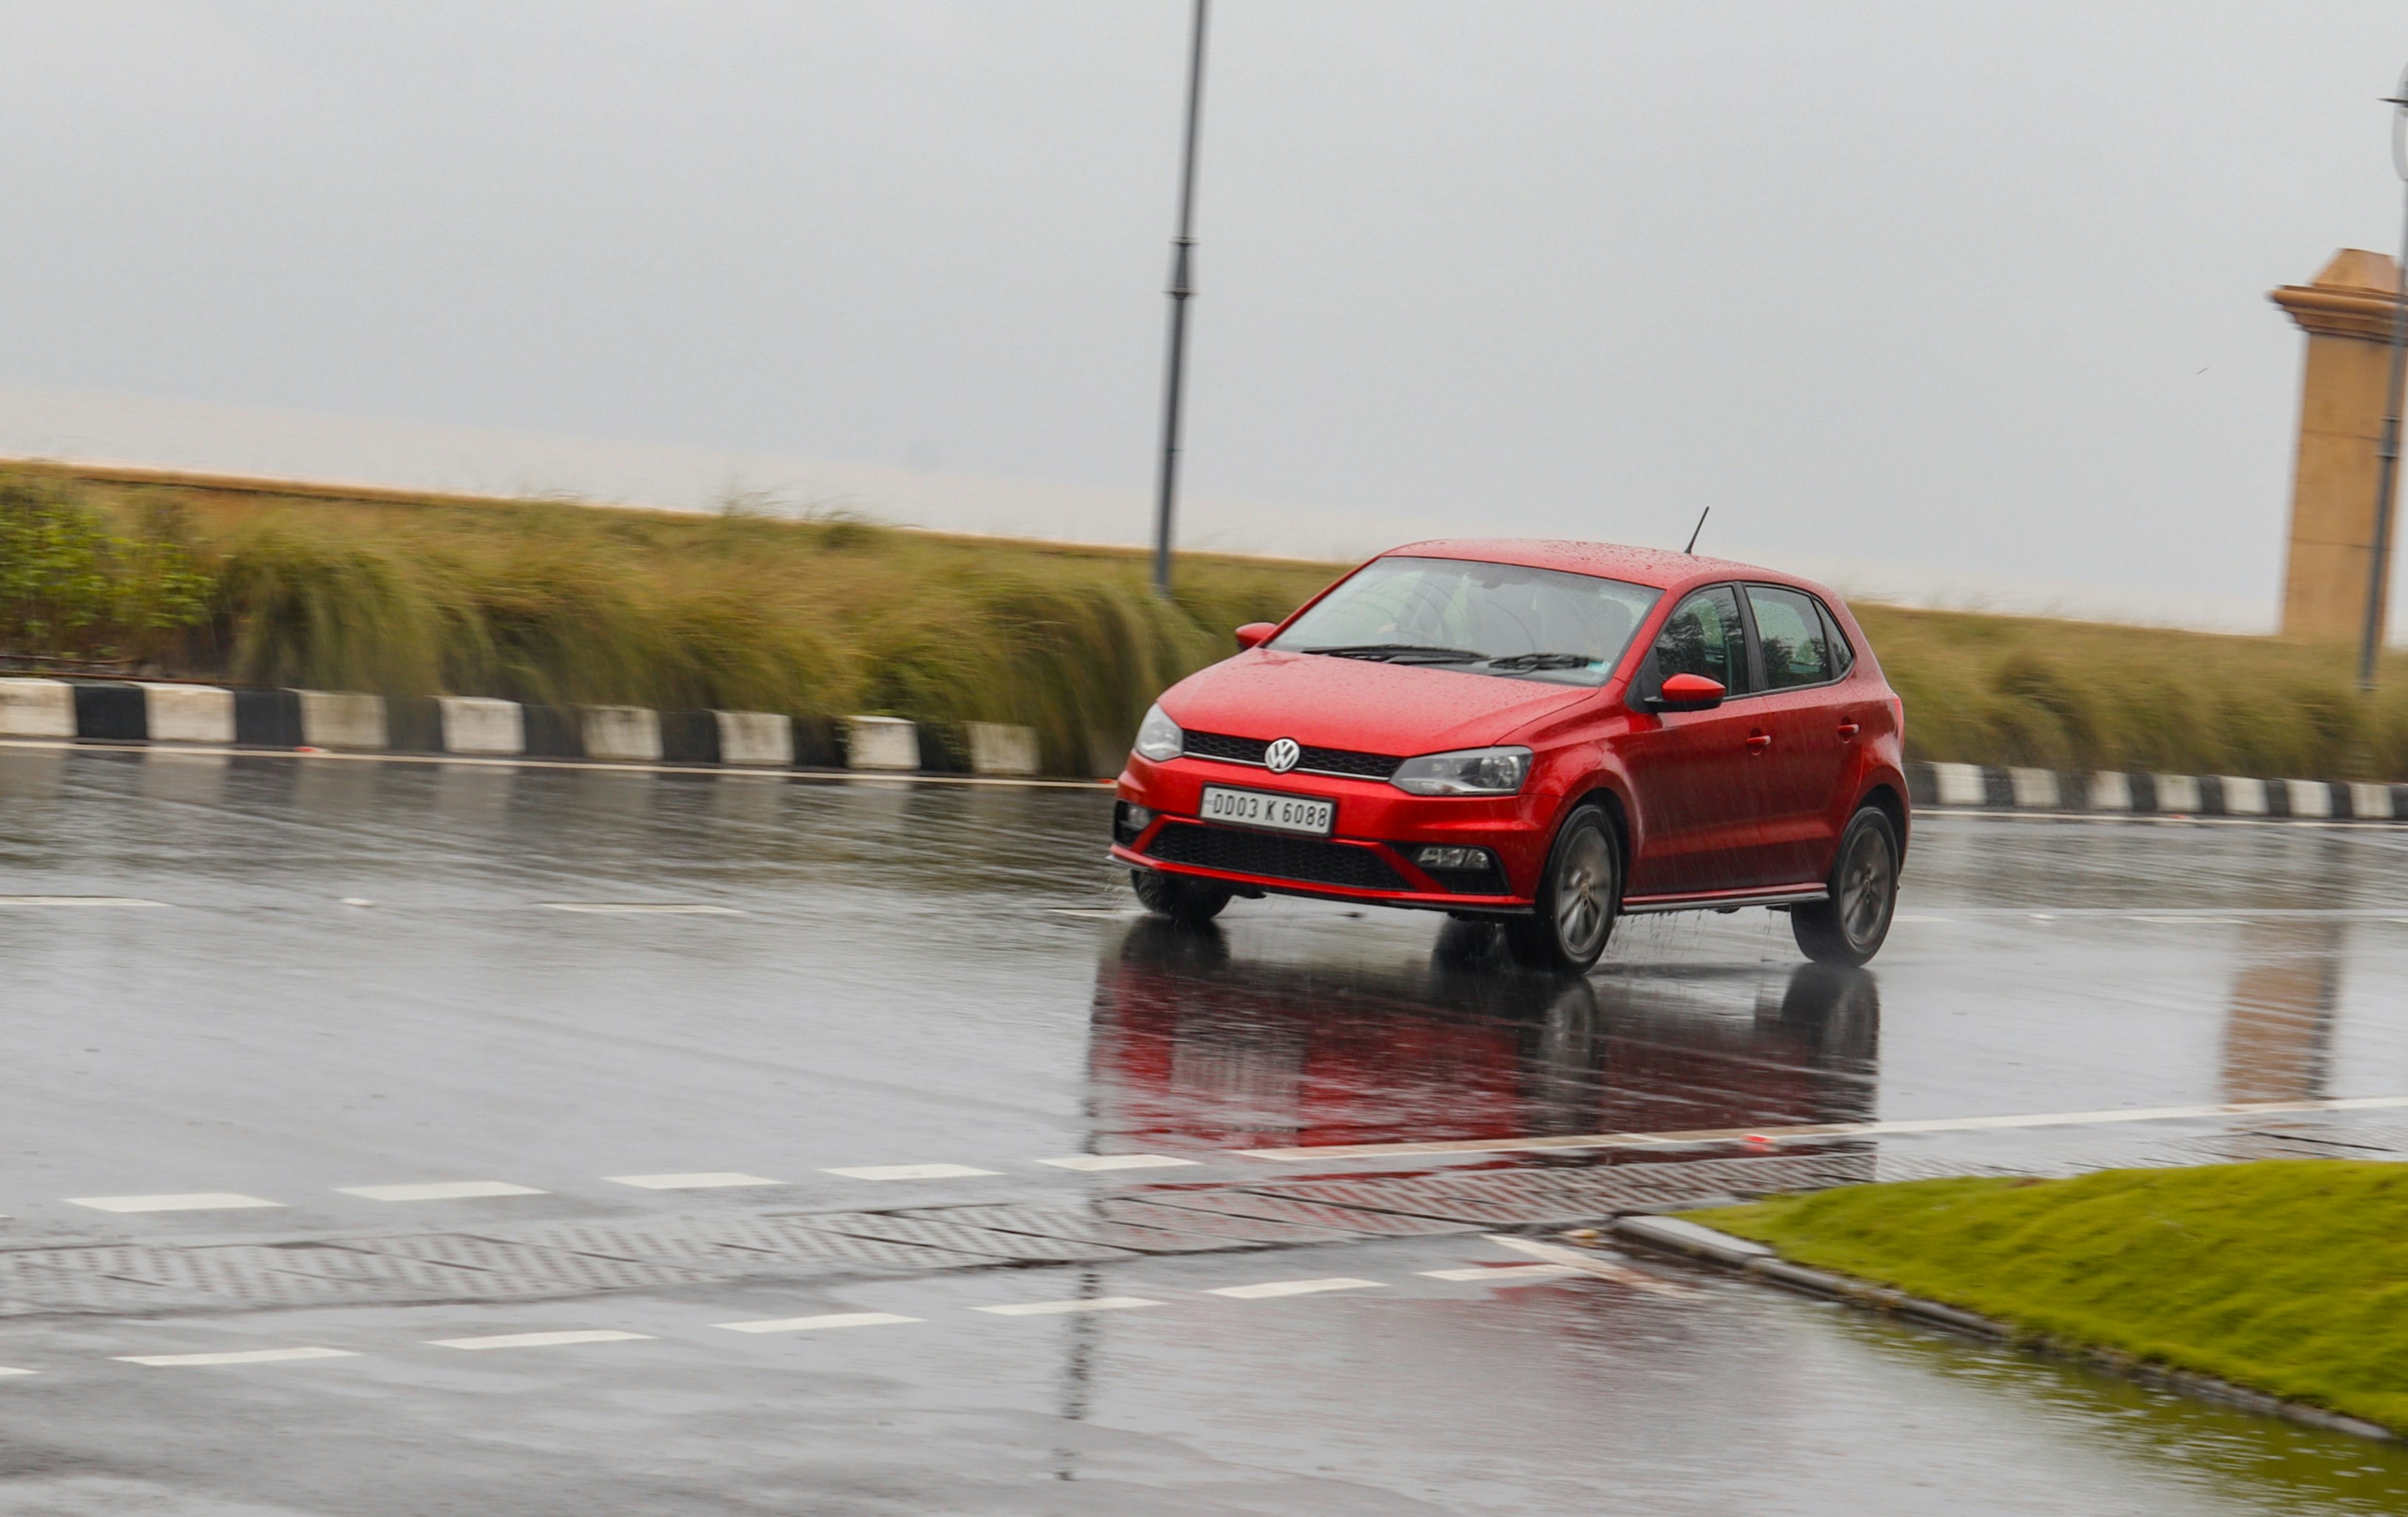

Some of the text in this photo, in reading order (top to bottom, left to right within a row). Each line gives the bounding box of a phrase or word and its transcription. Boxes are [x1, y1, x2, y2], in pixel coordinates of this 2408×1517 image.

[1213, 793, 1327, 827] DD03 K 6088
